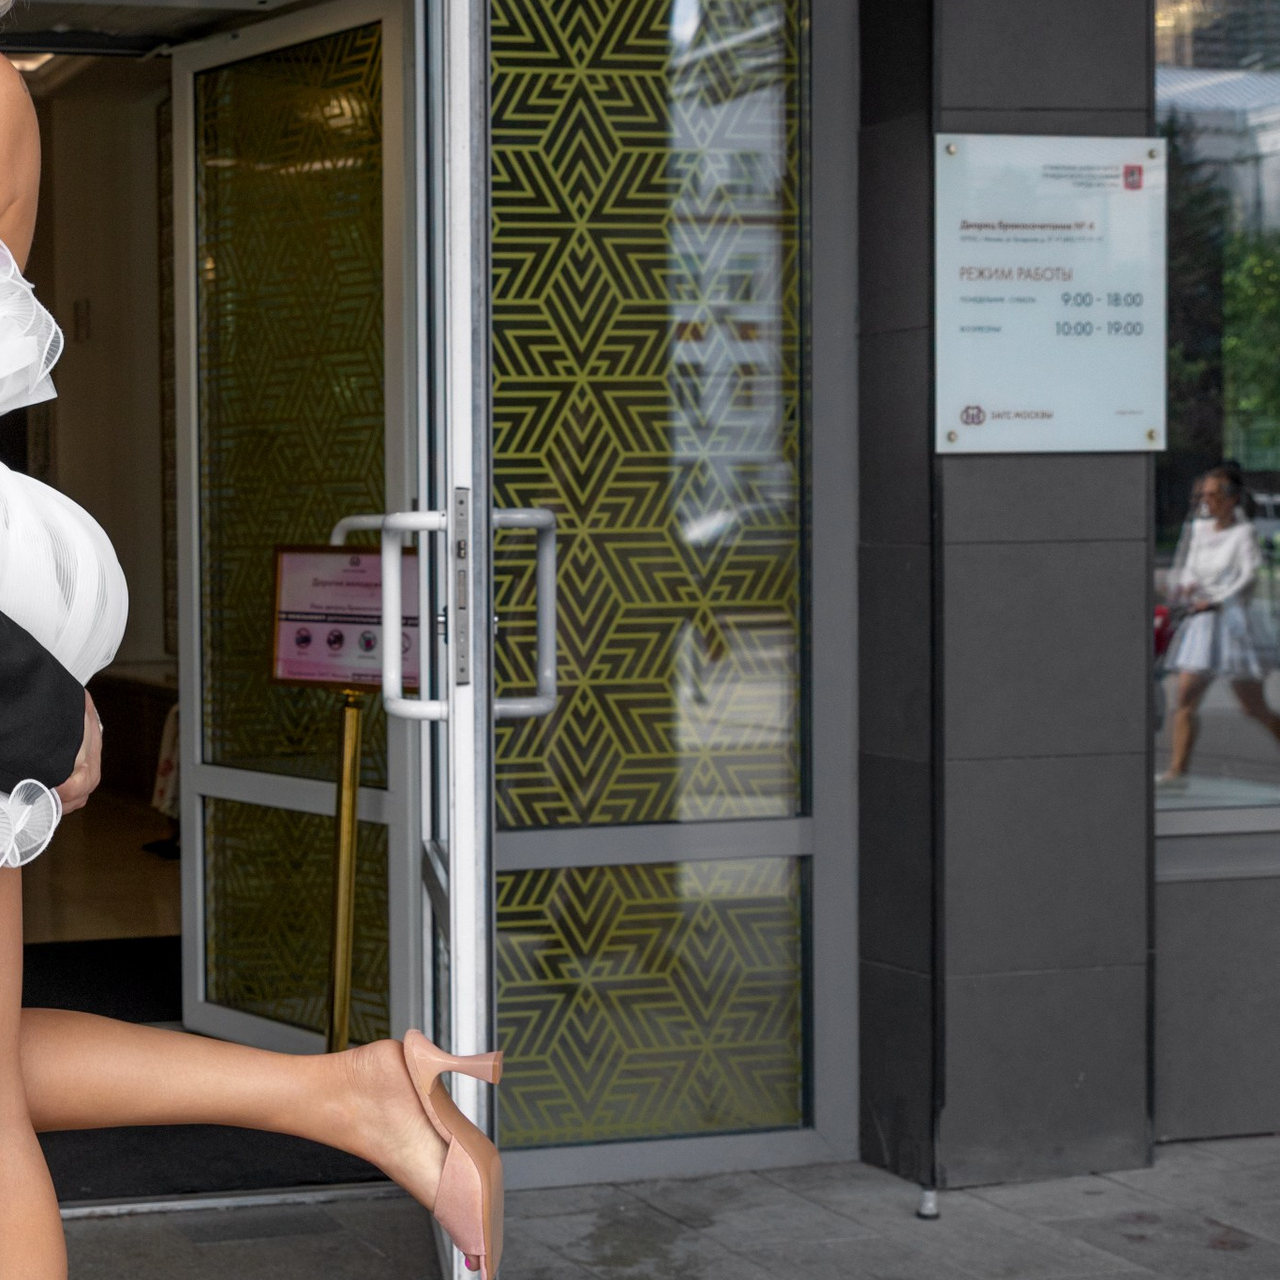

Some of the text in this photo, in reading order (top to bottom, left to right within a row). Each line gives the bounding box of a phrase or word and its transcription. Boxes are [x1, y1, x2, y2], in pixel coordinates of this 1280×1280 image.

[959, 266, 1073, 282] РЕЖИМ РАБОТЫ
[1061, 292, 1094, 307] 9:00
[1055, 321, 1094, 336] 10:00
[1106, 321, 1144, 336] 19:00
